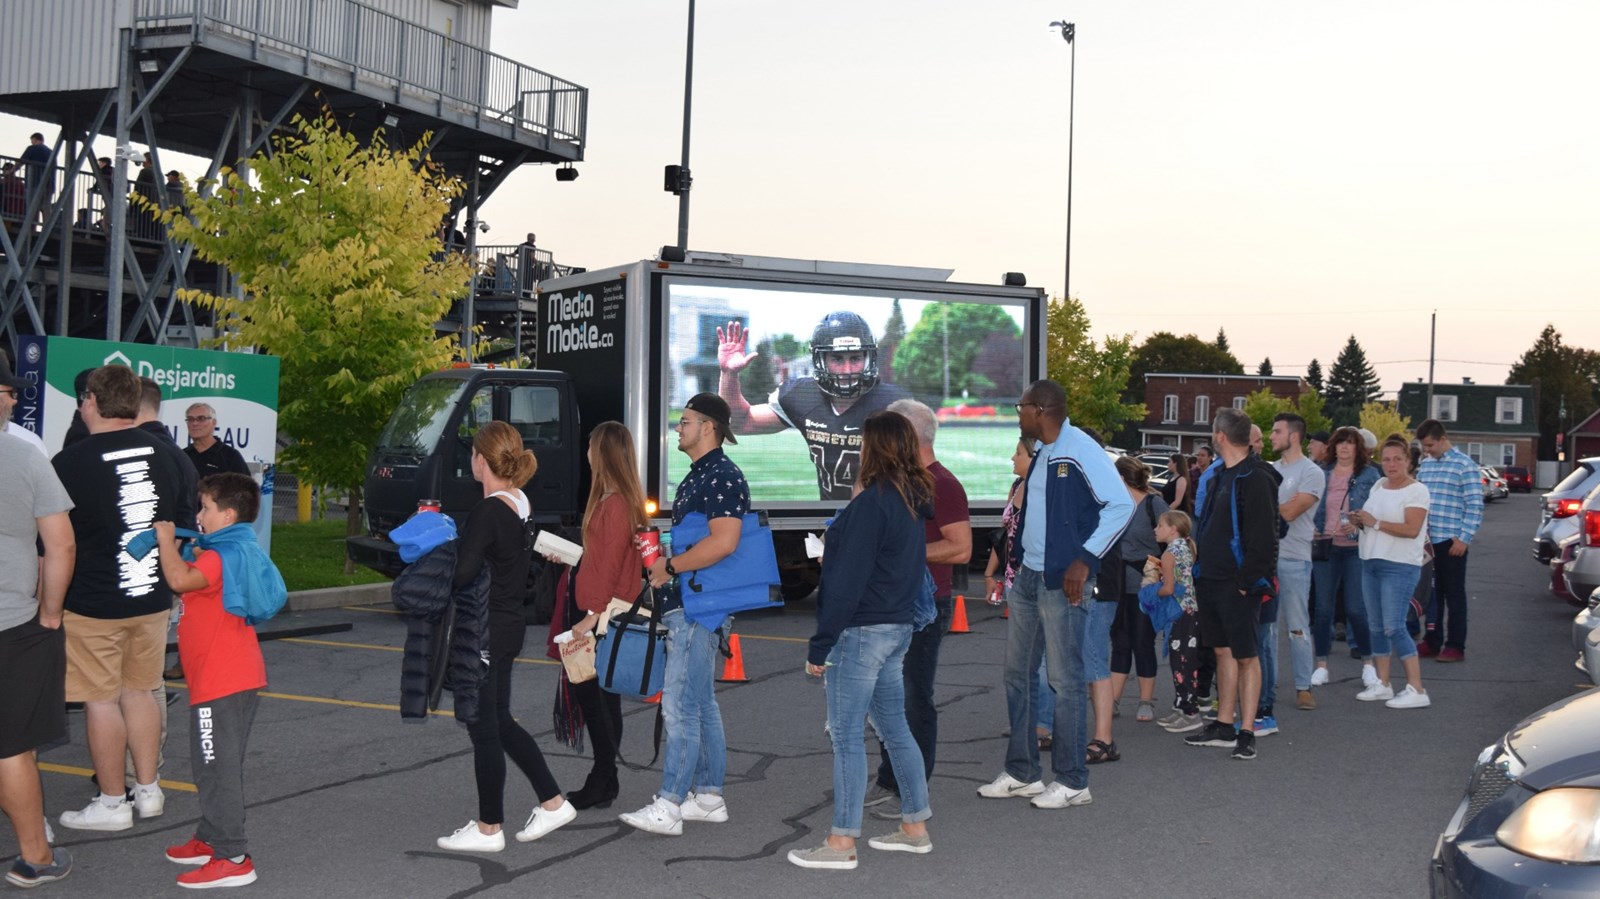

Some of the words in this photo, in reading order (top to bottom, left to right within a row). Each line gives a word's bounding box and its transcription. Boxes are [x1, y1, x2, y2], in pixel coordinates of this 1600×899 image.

[547, 290, 594, 323] Media
[546, 321, 614, 354] Mobile.ca
[138, 360, 236, 392] Desjardins
[198, 707, 215, 764] BENCH.
